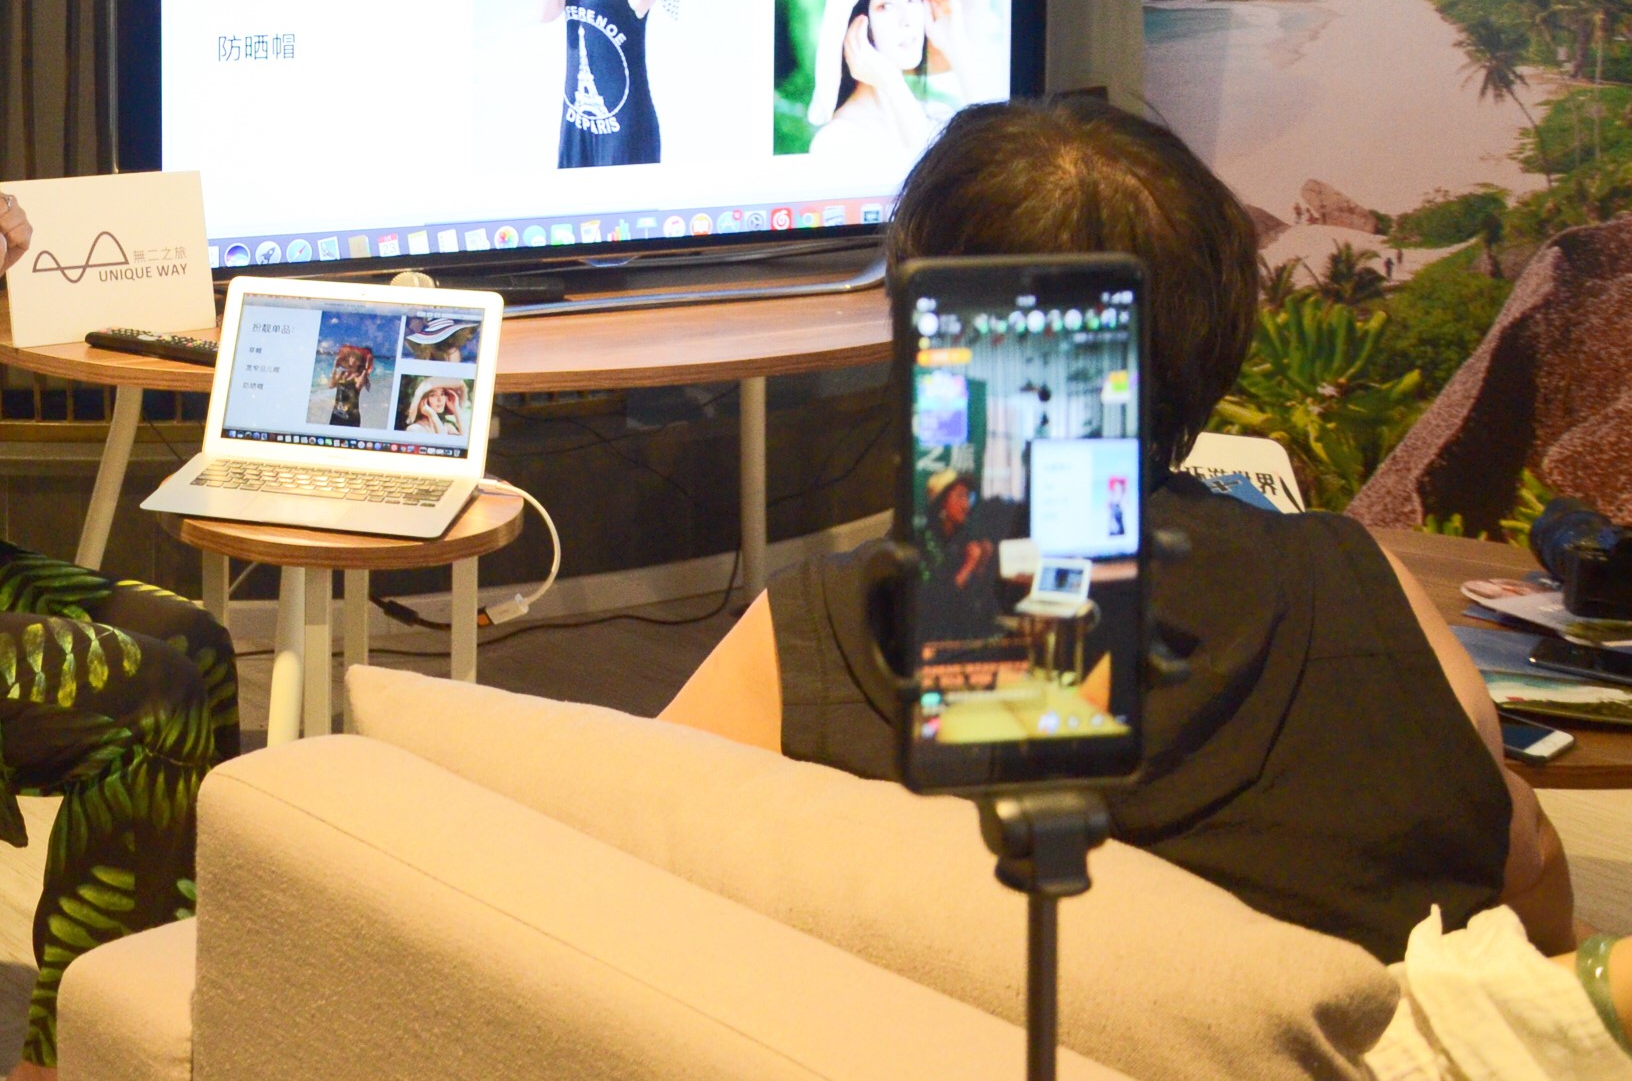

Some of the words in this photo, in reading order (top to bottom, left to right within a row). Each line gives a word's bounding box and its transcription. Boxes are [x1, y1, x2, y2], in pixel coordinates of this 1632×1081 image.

[217, 33, 296, 63] 防晒帽
[133, 246, 188, 264] 無二之旅
[98, 266, 153, 282] UNIQUE
[156, 263, 188, 277] WAY
